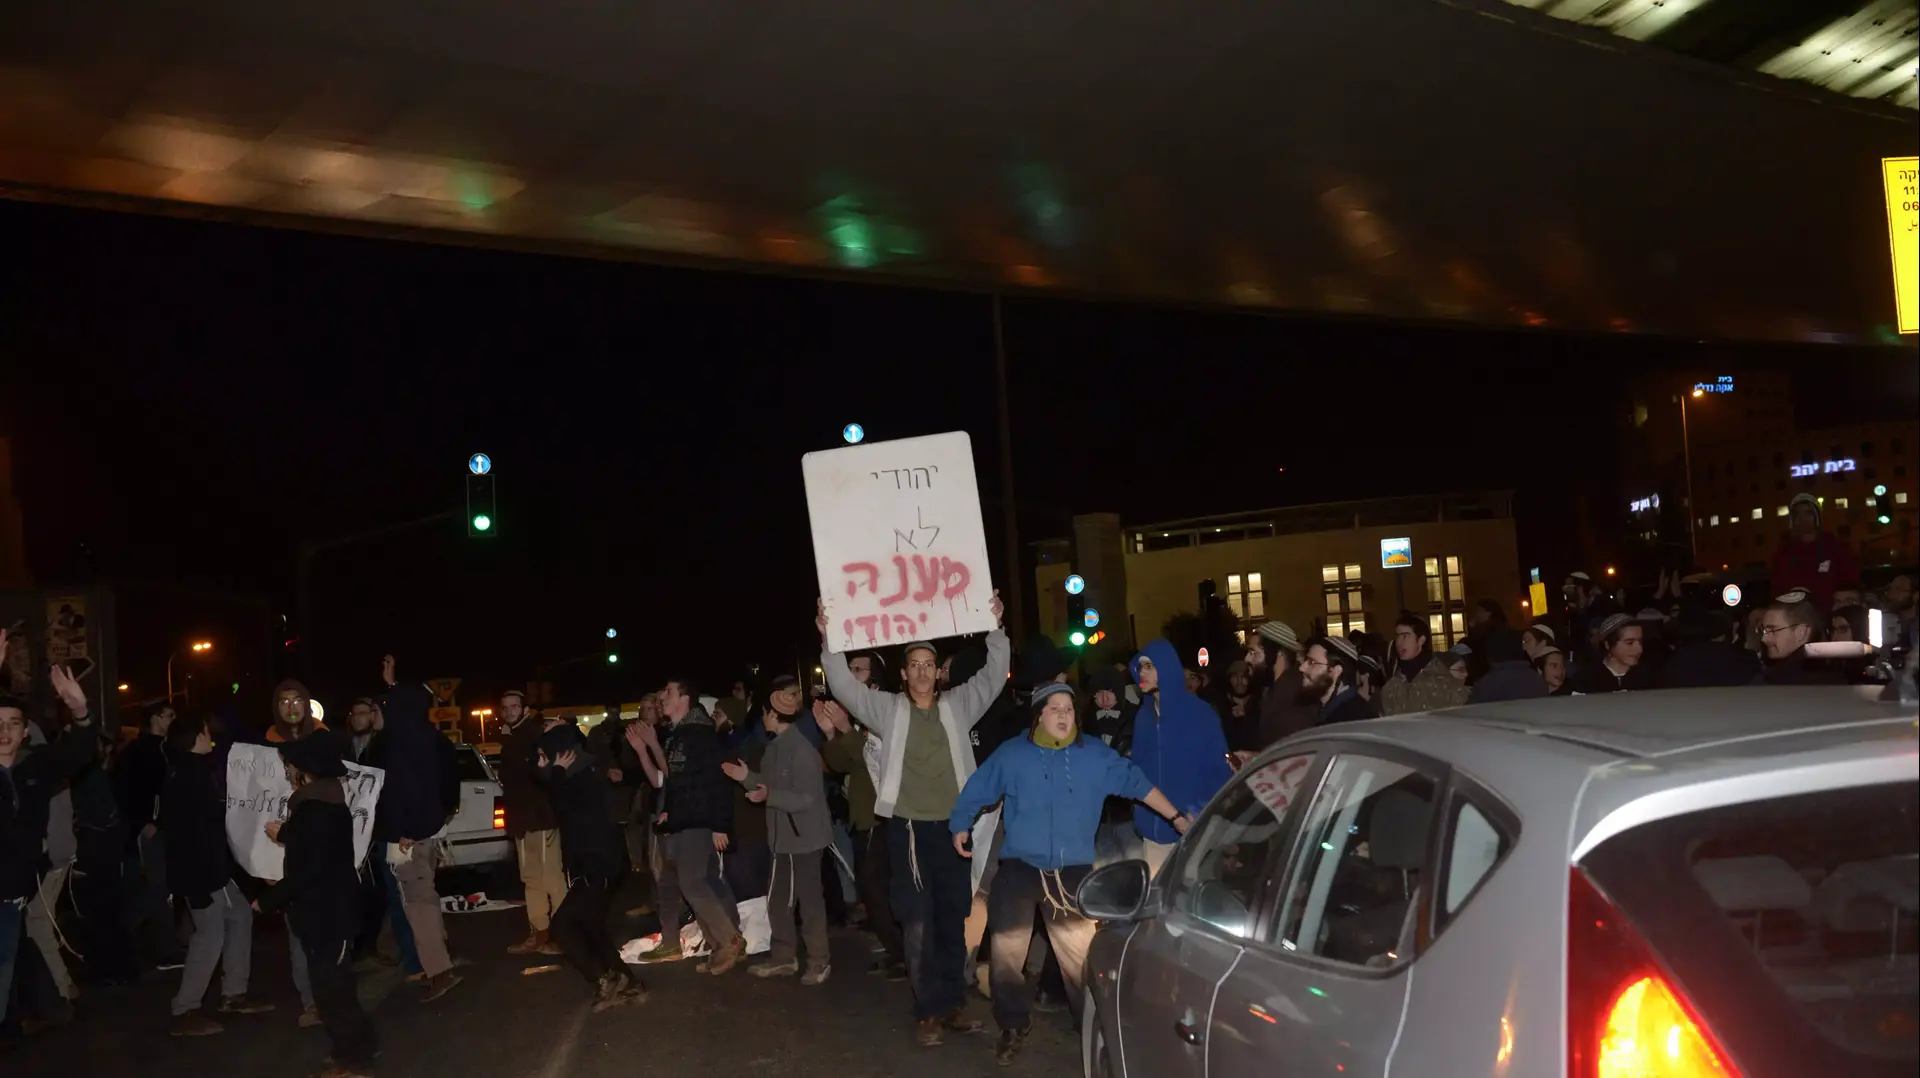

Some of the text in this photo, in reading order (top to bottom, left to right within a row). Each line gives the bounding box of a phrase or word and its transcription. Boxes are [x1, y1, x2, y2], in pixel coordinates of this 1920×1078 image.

[870, 465, 939, 490] יהודי
[1791, 459, 1856, 477] בית יהב
[893, 505, 941, 552] לא
[843, 612, 928, 646] יהודי
